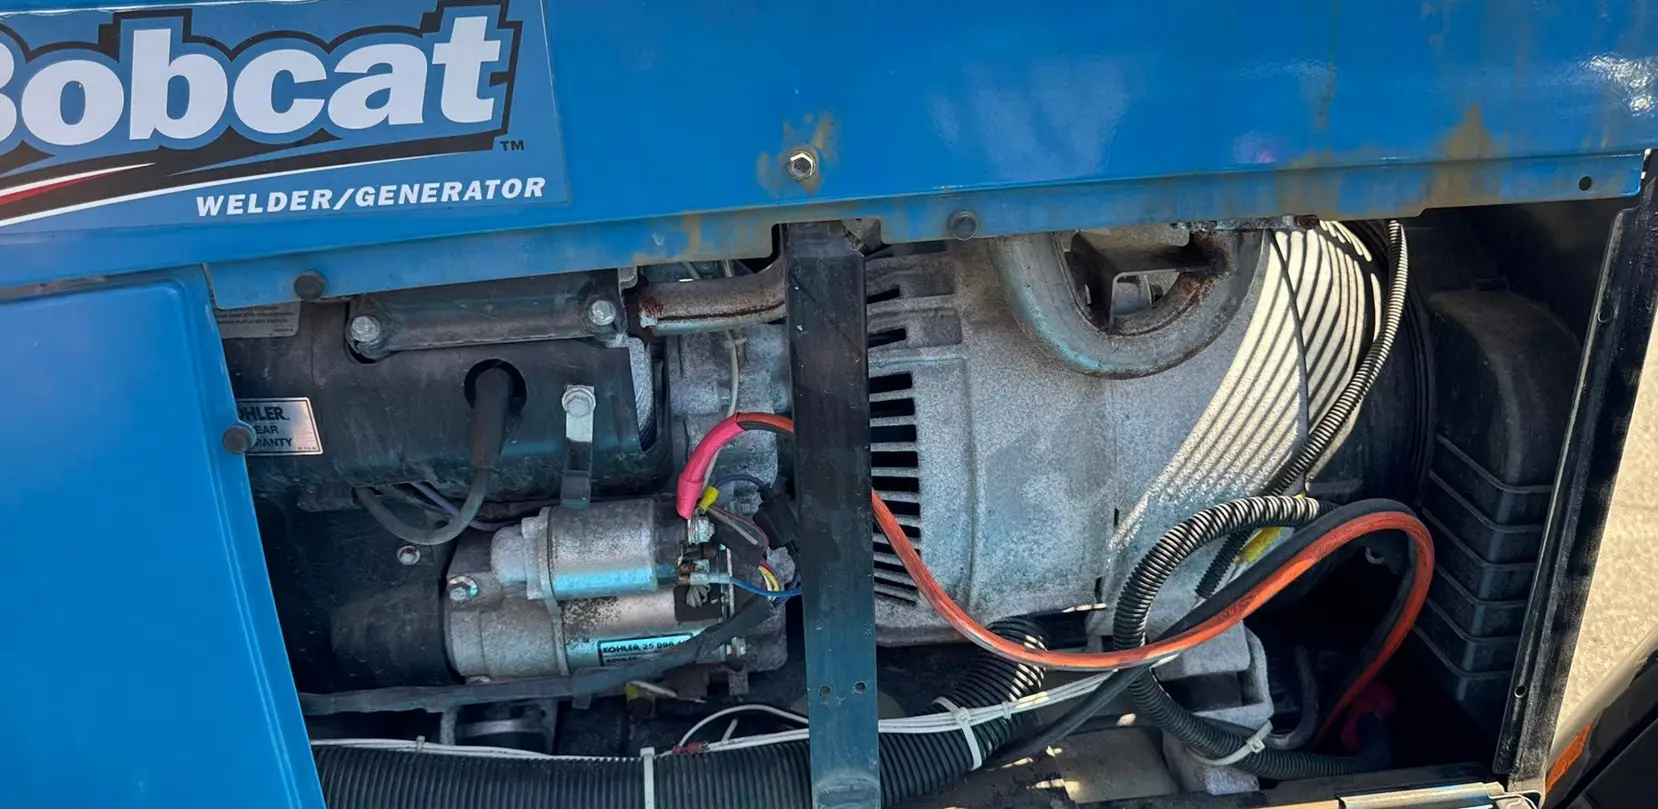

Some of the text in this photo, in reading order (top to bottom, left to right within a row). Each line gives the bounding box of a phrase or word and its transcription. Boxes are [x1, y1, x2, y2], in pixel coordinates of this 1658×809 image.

[0, 16, 501, 146] obcat
[499, 140, 525, 152] TM
[196, 177, 546, 217] WELDER/GENERATOR
[603, 645, 640, 653] KOHLER
